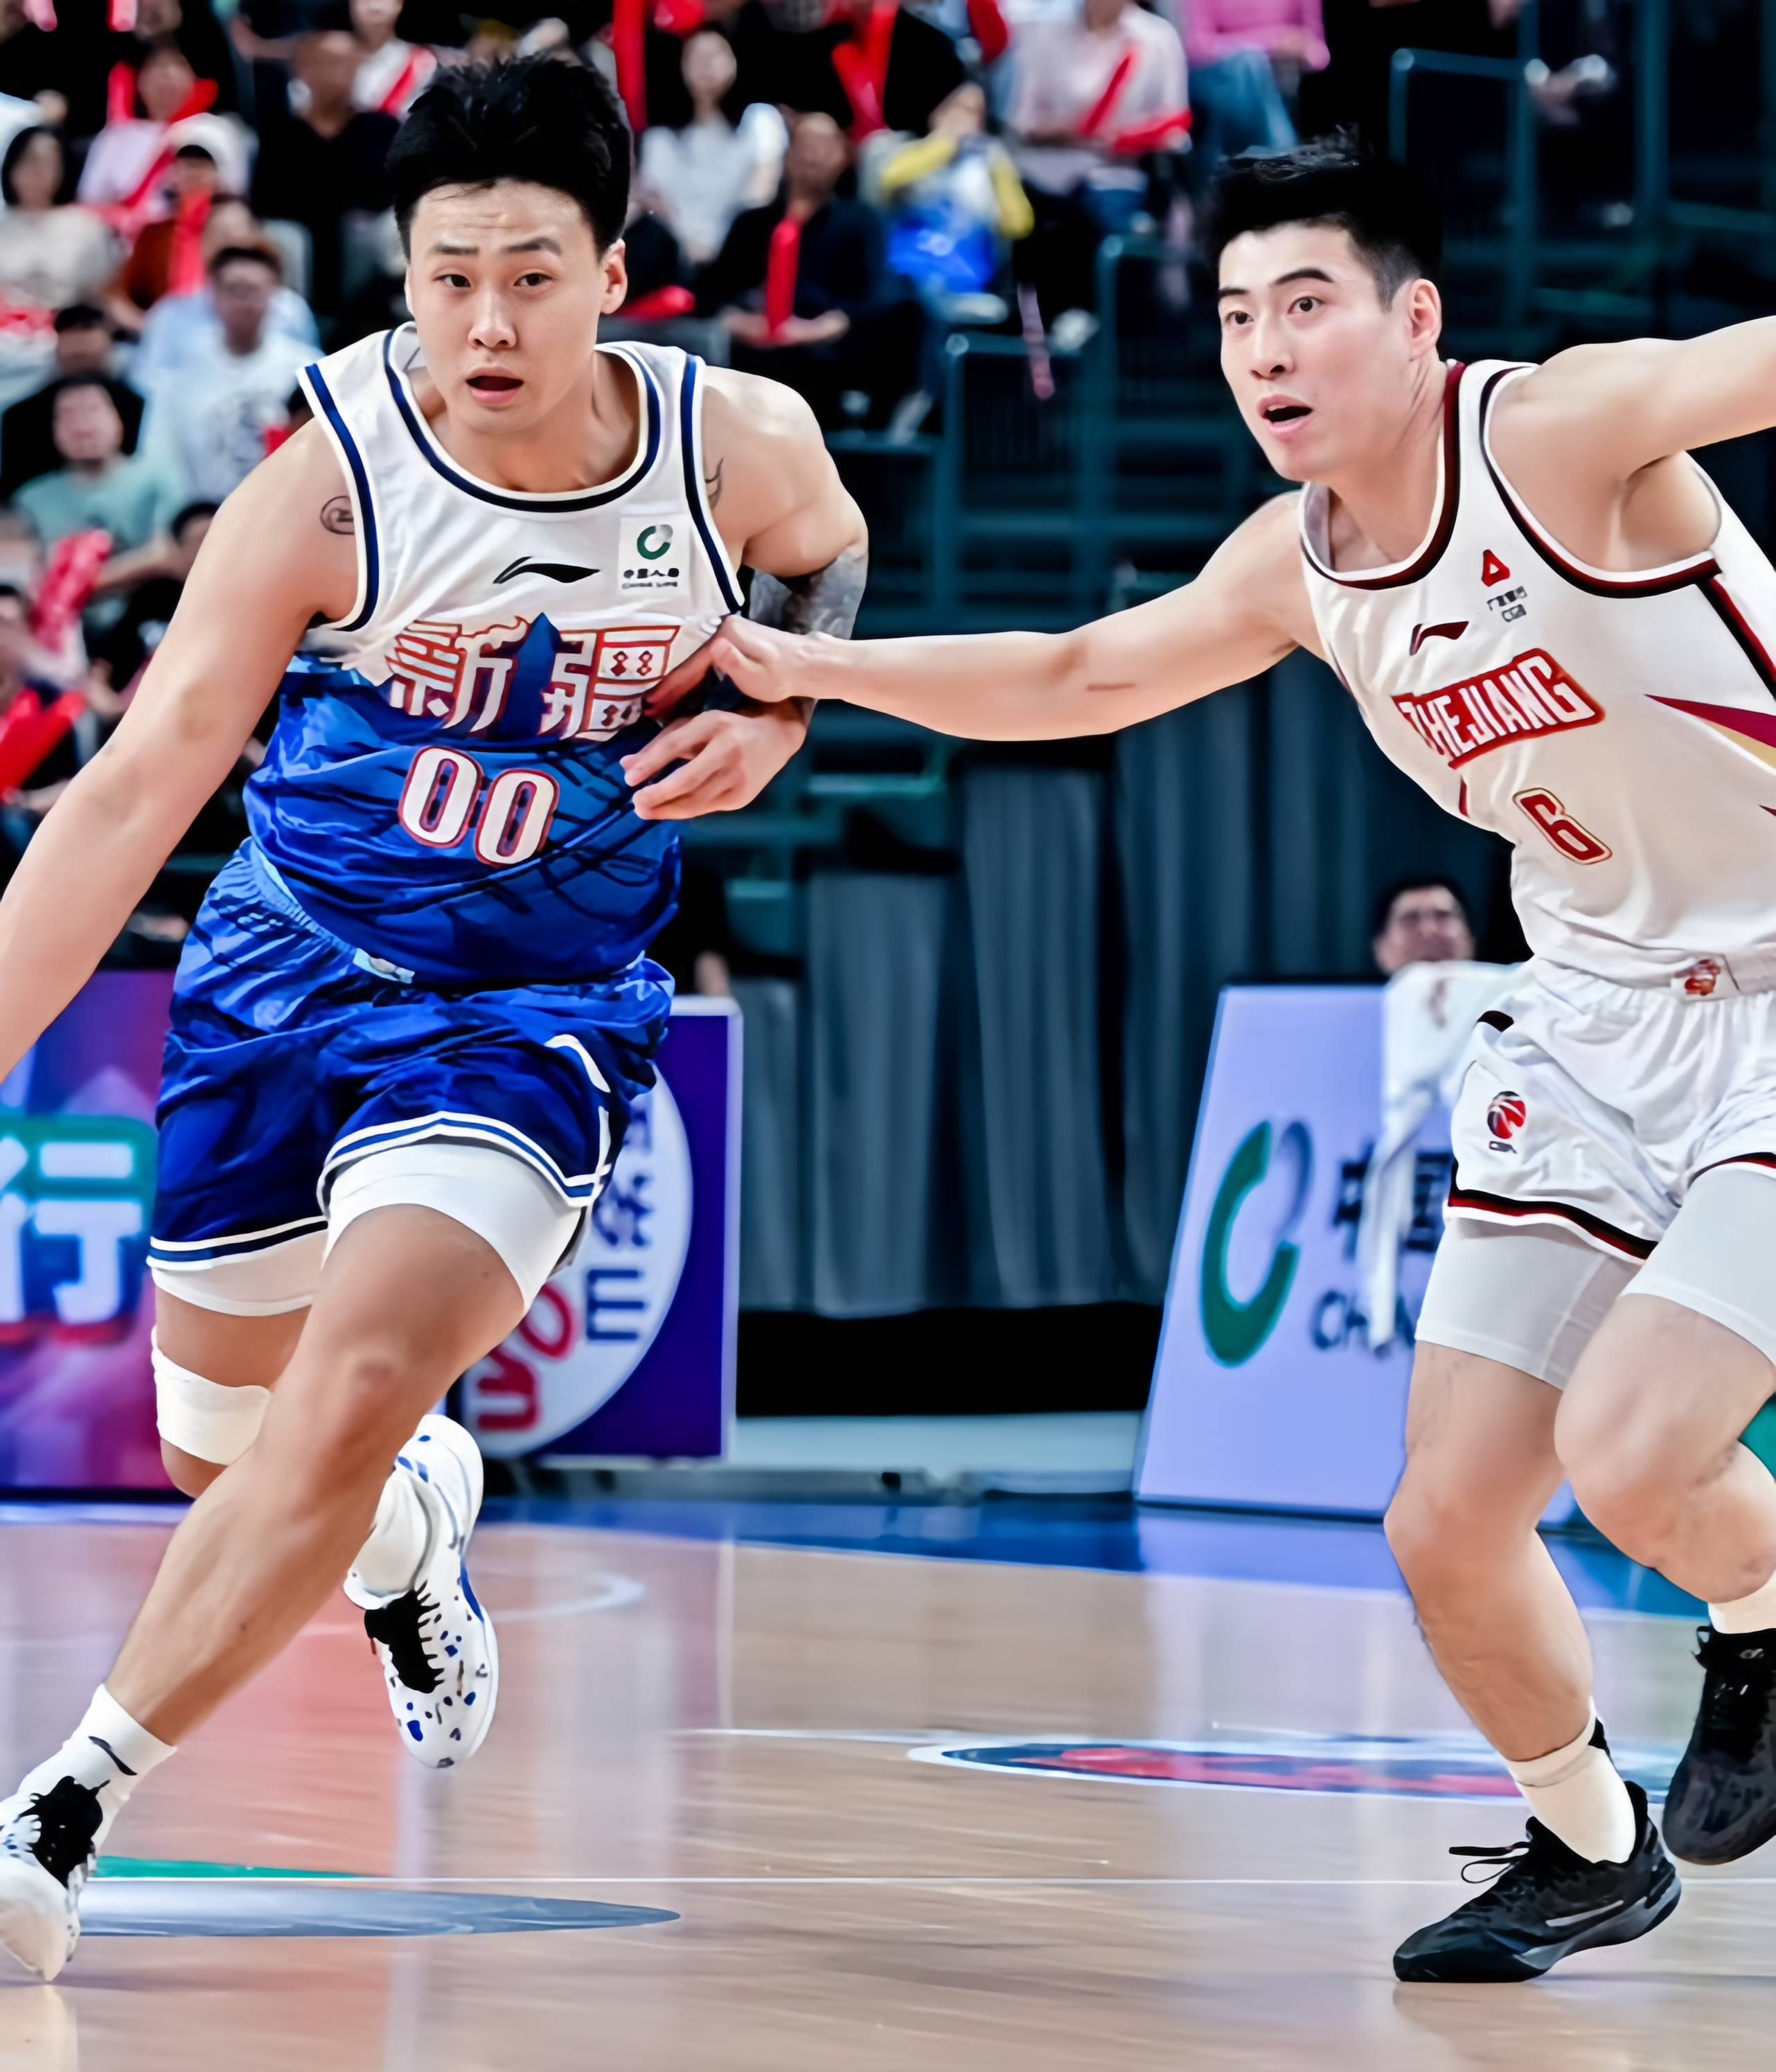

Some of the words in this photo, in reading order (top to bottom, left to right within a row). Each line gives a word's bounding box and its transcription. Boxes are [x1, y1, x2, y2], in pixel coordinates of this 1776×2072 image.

[384, 614, 682, 742] 新疆
[398, 745, 560, 868] 00
[1512, 787, 1613, 865] 6
